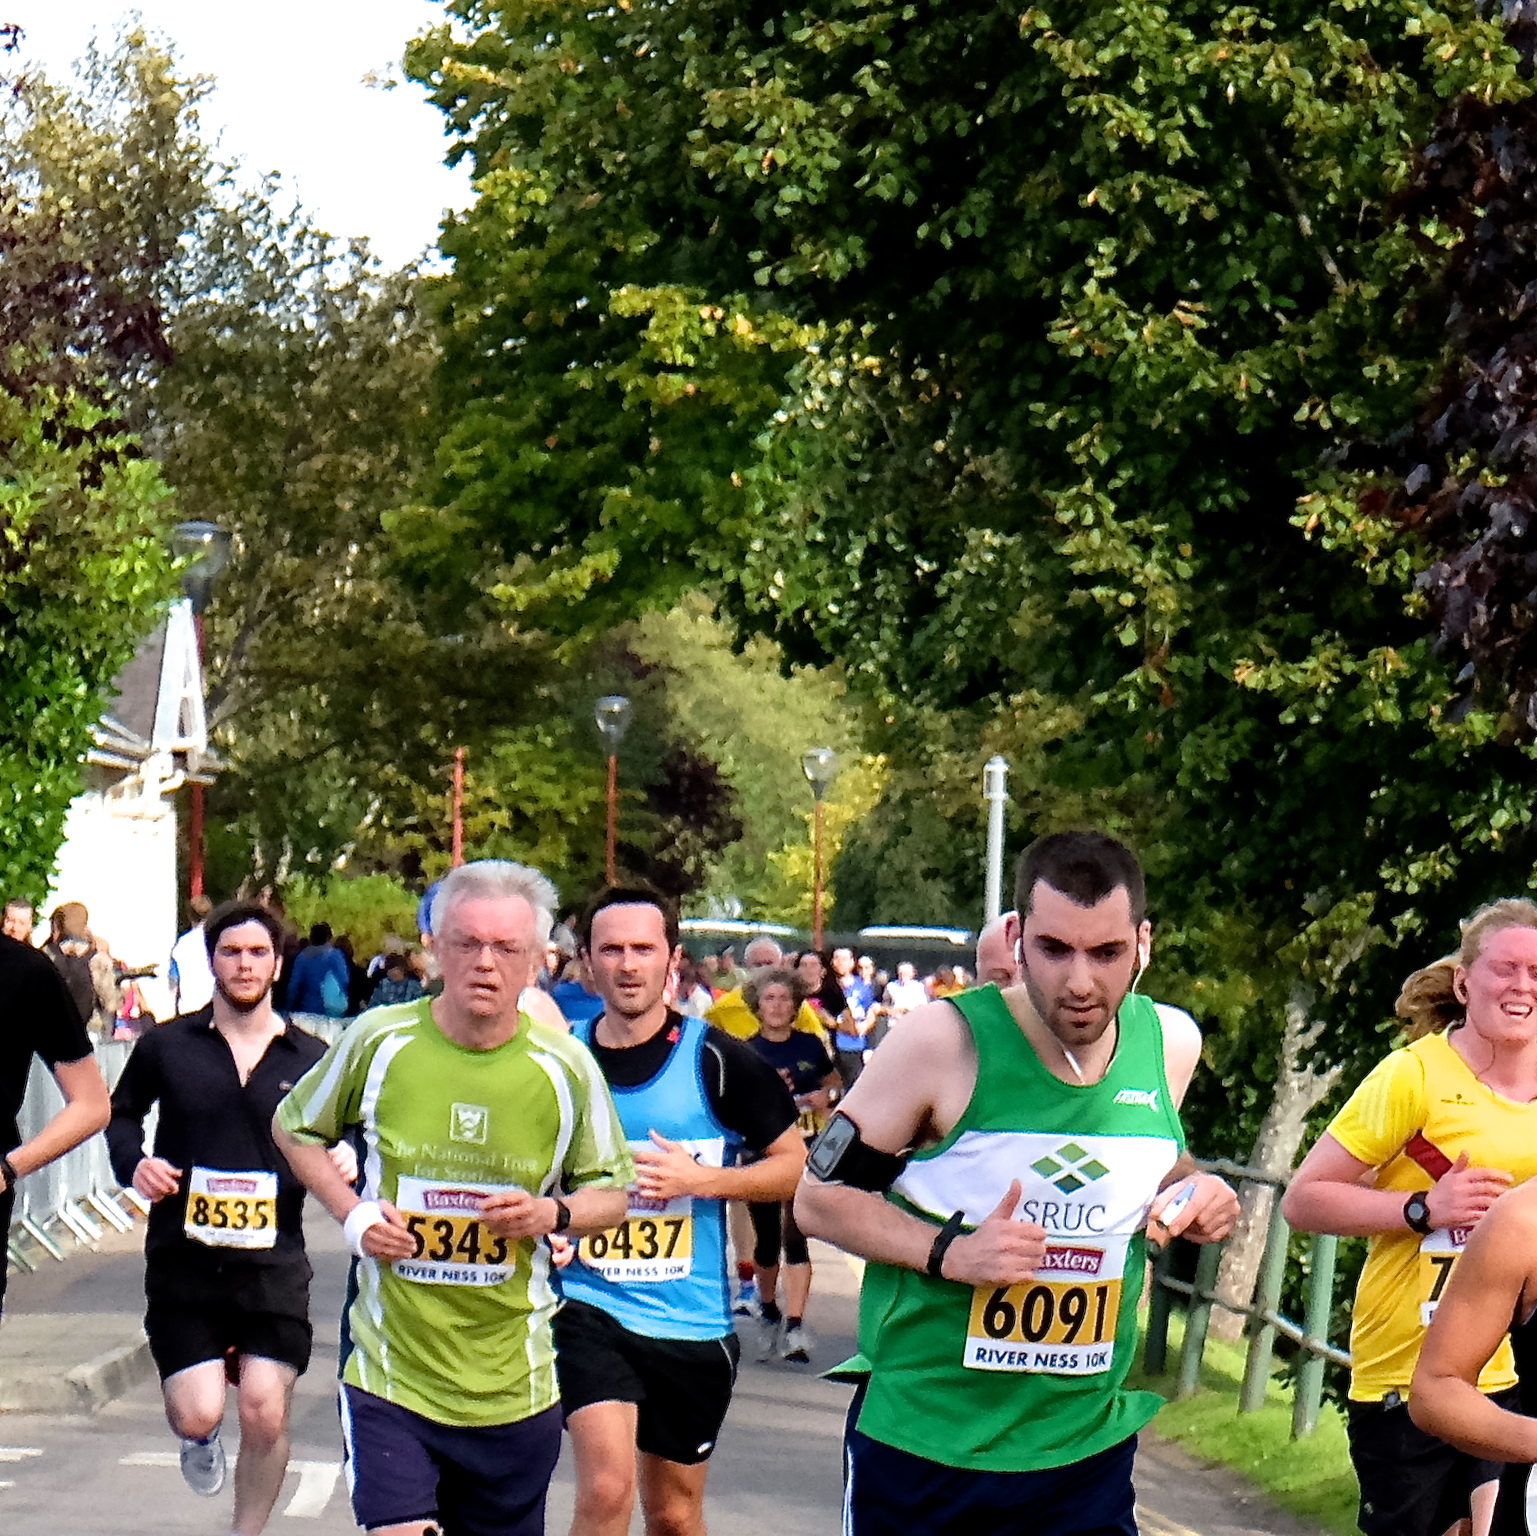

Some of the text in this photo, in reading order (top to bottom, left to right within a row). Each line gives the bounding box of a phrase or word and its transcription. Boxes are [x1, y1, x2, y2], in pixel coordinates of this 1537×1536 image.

[193, 1196, 268, 1230] 8535
[1023, 1199, 1106, 1232] SRUC
[406, 1217, 508, 1264] 5343
[589, 1219, 684, 1259] 6437
[398, 1265, 436, 1280] RIVER
[442, 1268, 477, 1283] NESS
[626, 1266, 659, 1277] NESS
[983, 1285, 1108, 1344] 6091
[975, 1347, 1107, 1369] RIVER NESS 10K
